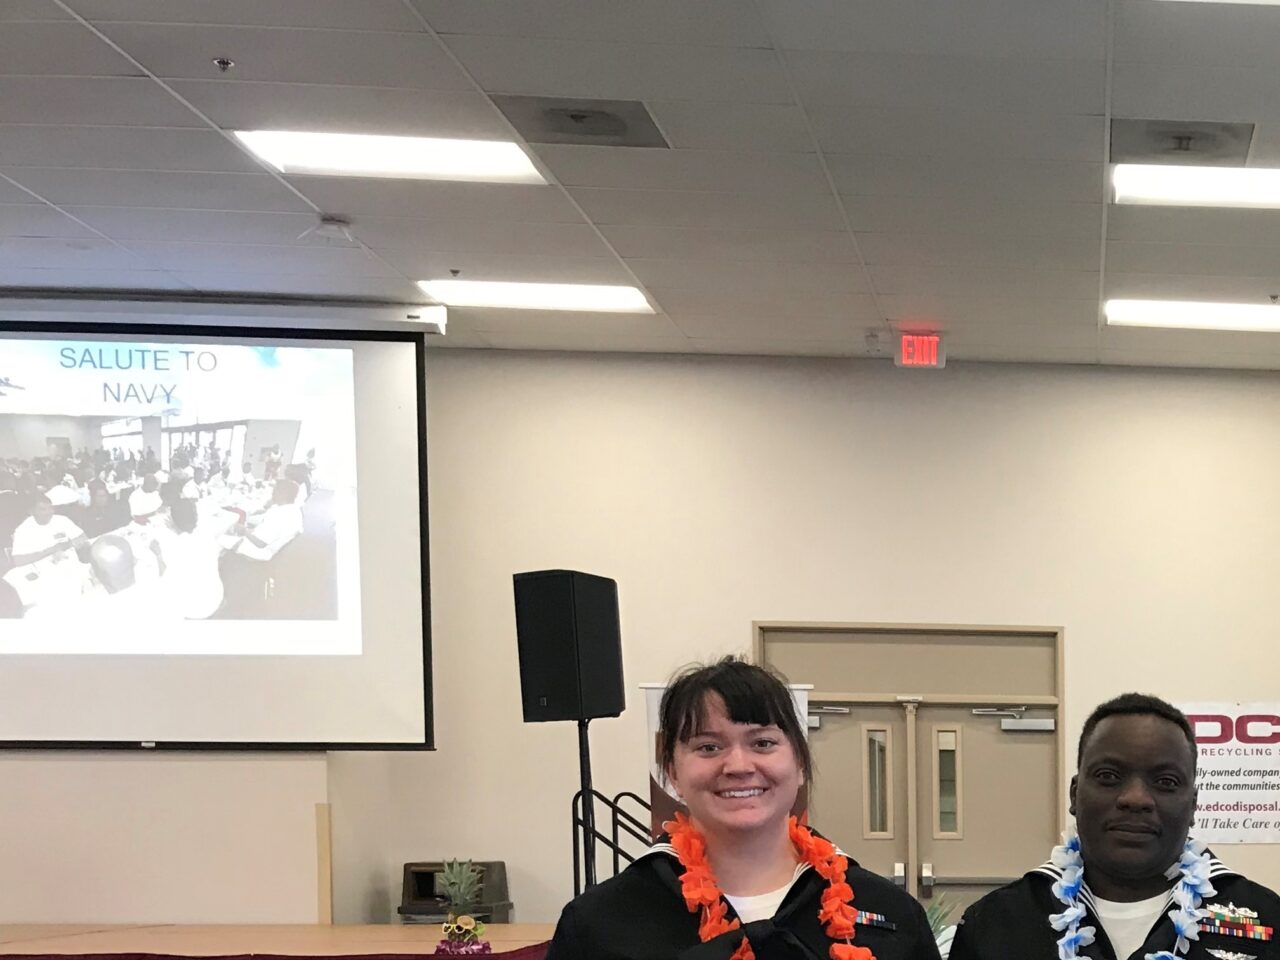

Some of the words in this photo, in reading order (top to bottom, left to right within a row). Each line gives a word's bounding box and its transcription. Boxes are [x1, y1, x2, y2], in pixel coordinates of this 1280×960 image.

[902, 335, 940, 365] EXIT
[59, 346, 171, 371] SALUTE
[179, 350, 218, 372] TO
[103, 382, 177, 404] NAVY
[1201, 748, 1273, 756] RECYCLING
[1196, 768, 1242, 779] ily-owned
[1195, 783, 1204, 791] ut
[1206, 781, 1220, 790] the
[1222, 781, 1280, 790] communities
[1212, 818, 1239, 829] Take
[1242, 818, 1270, 829] Care
